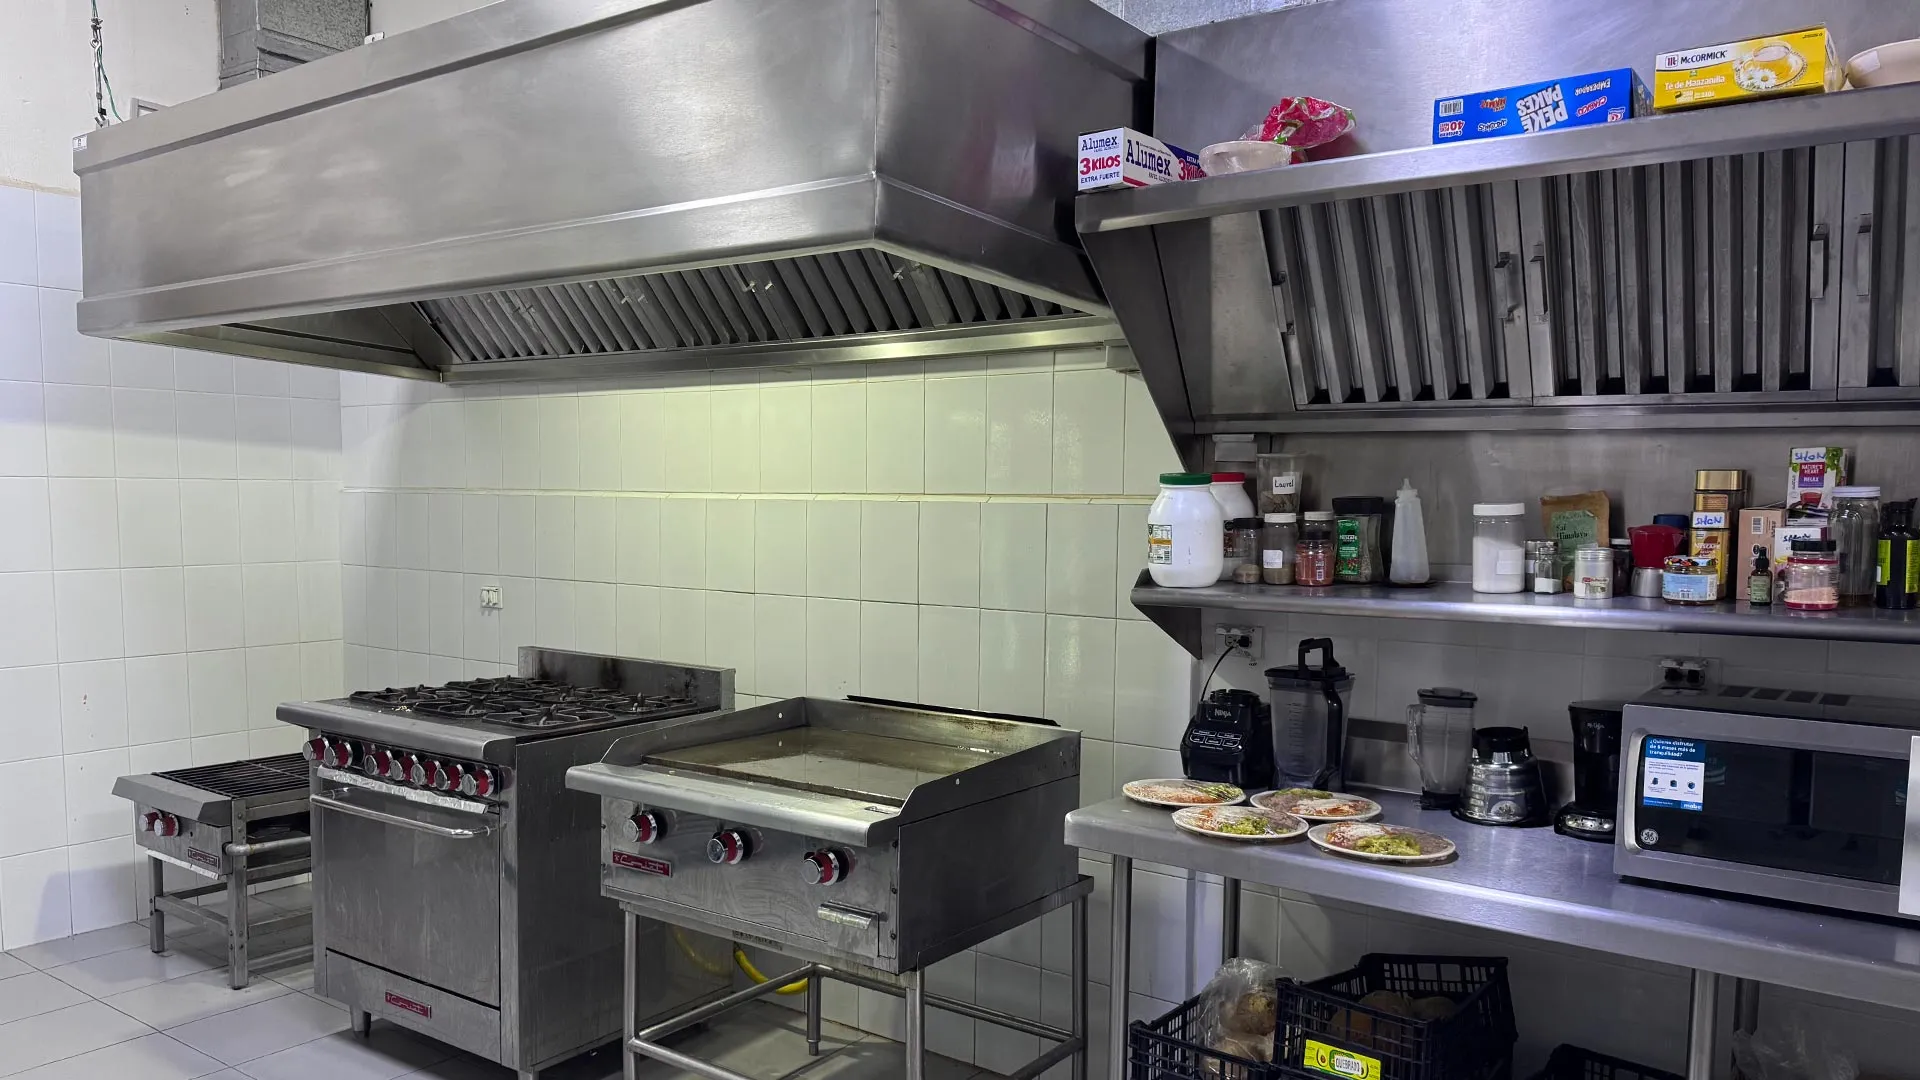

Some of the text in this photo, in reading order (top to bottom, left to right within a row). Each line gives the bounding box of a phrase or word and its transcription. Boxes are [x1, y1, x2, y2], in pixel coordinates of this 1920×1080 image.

[1680, 50, 1726, 65] McCORMICK
[1674, 80, 1684, 89] de
[1685, 75, 1725, 88] Manzanilla
[1515, 83, 1563, 117] PAKES
[1520, 100, 1569, 133] PEKE
[1450, 120, 1464, 131] 40
[1081, 136, 1118, 151] Alumex
[1125, 138, 1172, 177] Alumex
[1081, 171, 1120, 183] EXTRA FUERTE
